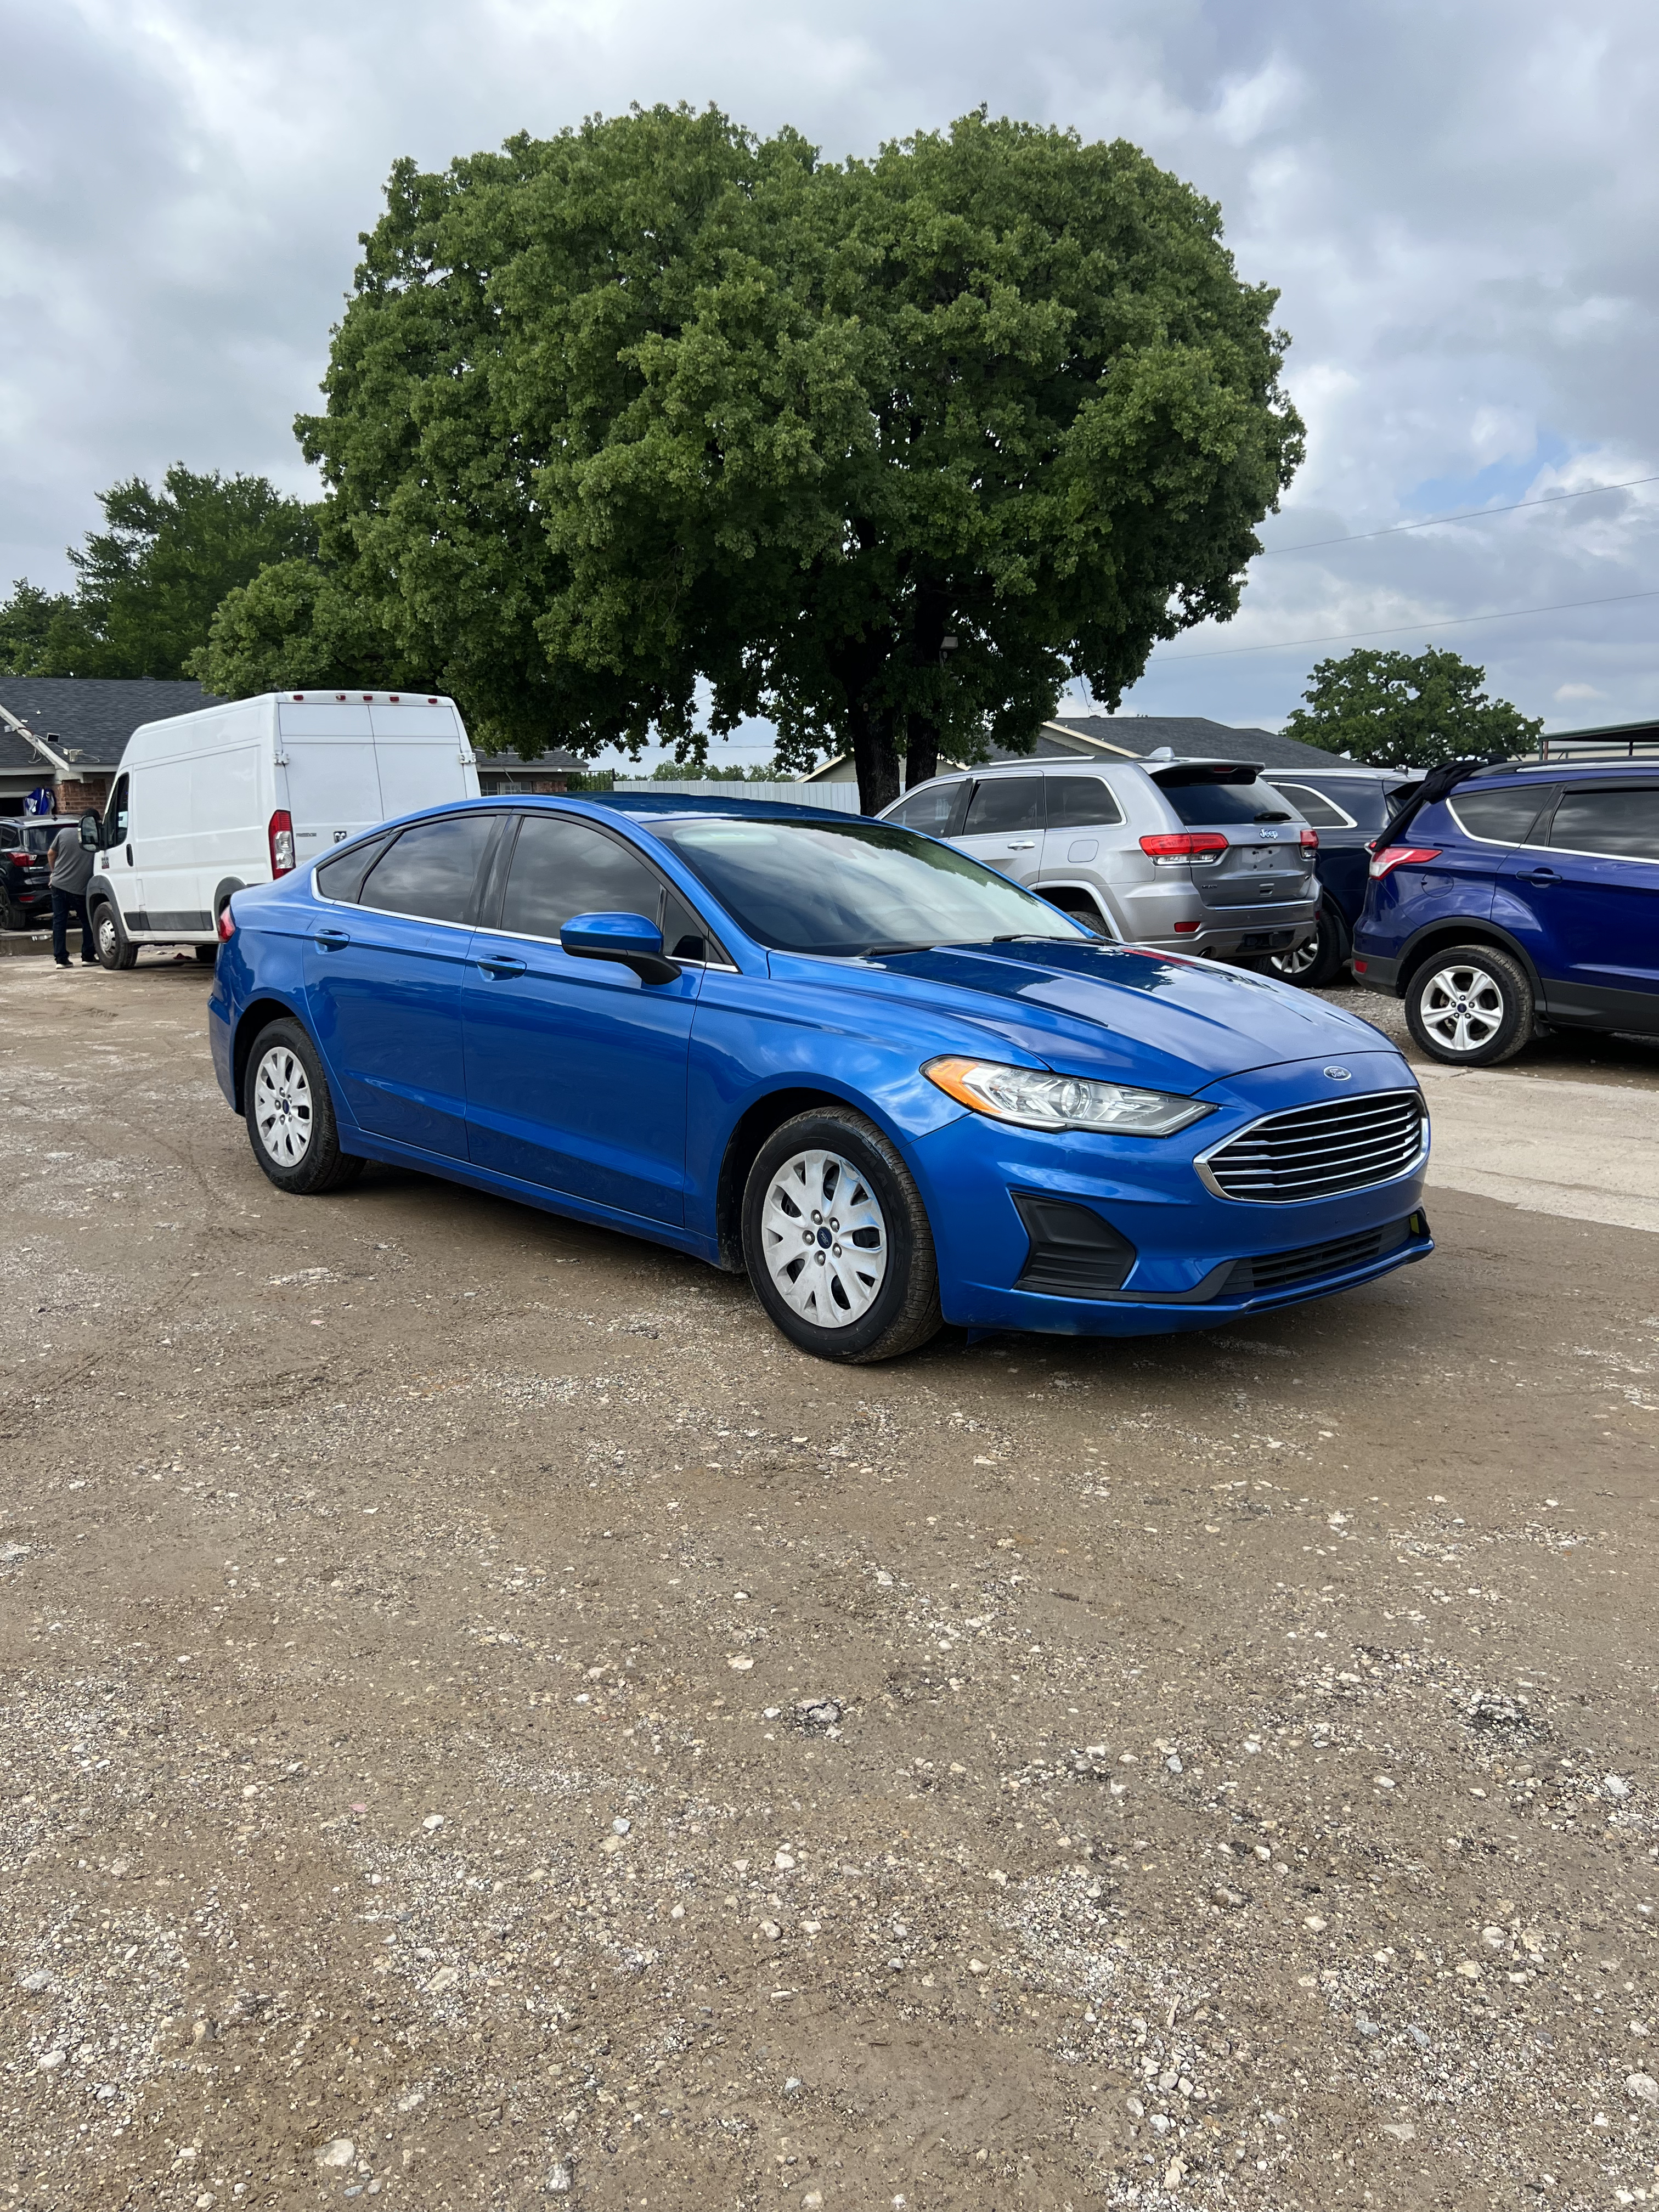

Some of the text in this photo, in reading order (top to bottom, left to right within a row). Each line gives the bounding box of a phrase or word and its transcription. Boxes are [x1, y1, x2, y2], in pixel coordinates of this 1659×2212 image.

[1259, 828, 1278, 839] Jeep
[1329, 1068, 1347, 1078] Ford
[861, 1152, 905, 1272] MAXXIS
